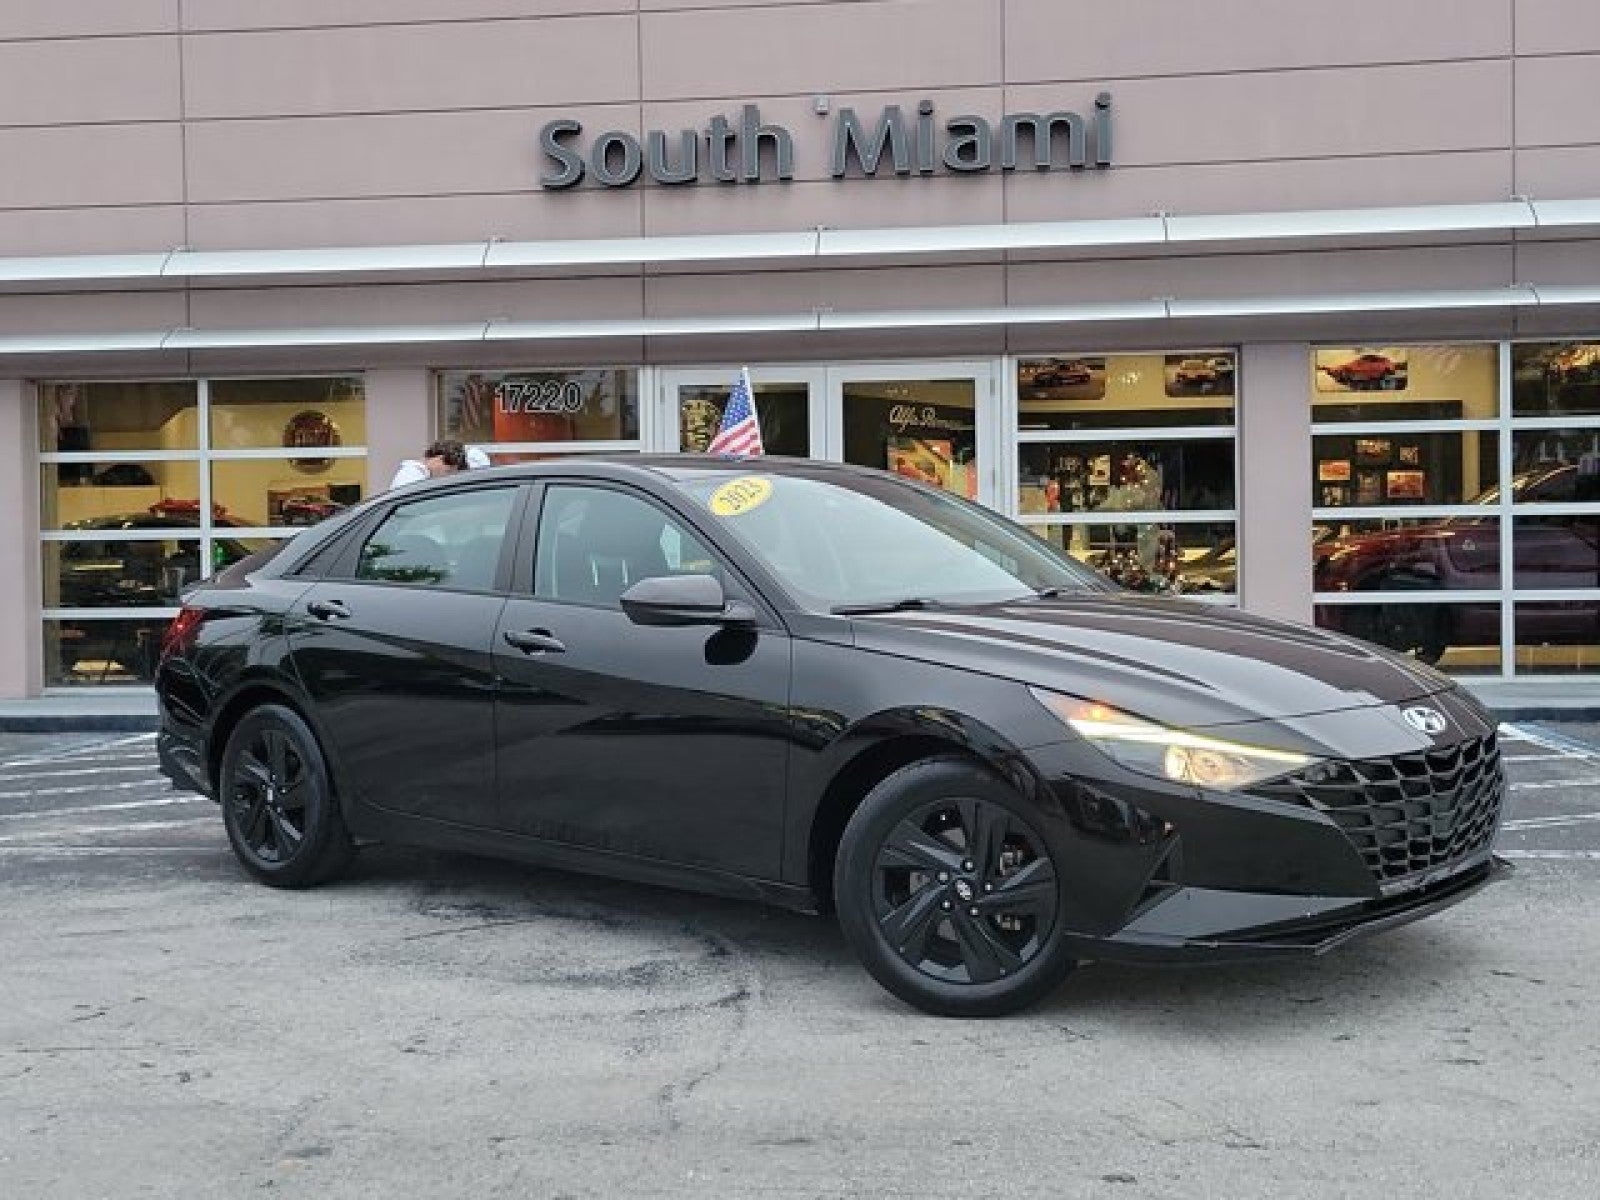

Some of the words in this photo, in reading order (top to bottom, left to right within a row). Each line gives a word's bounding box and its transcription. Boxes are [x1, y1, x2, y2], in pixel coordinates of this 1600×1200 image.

[540, 104, 794, 189] South
[831, 92, 1113, 179] Miami
[495, 380, 583, 414] 17220
